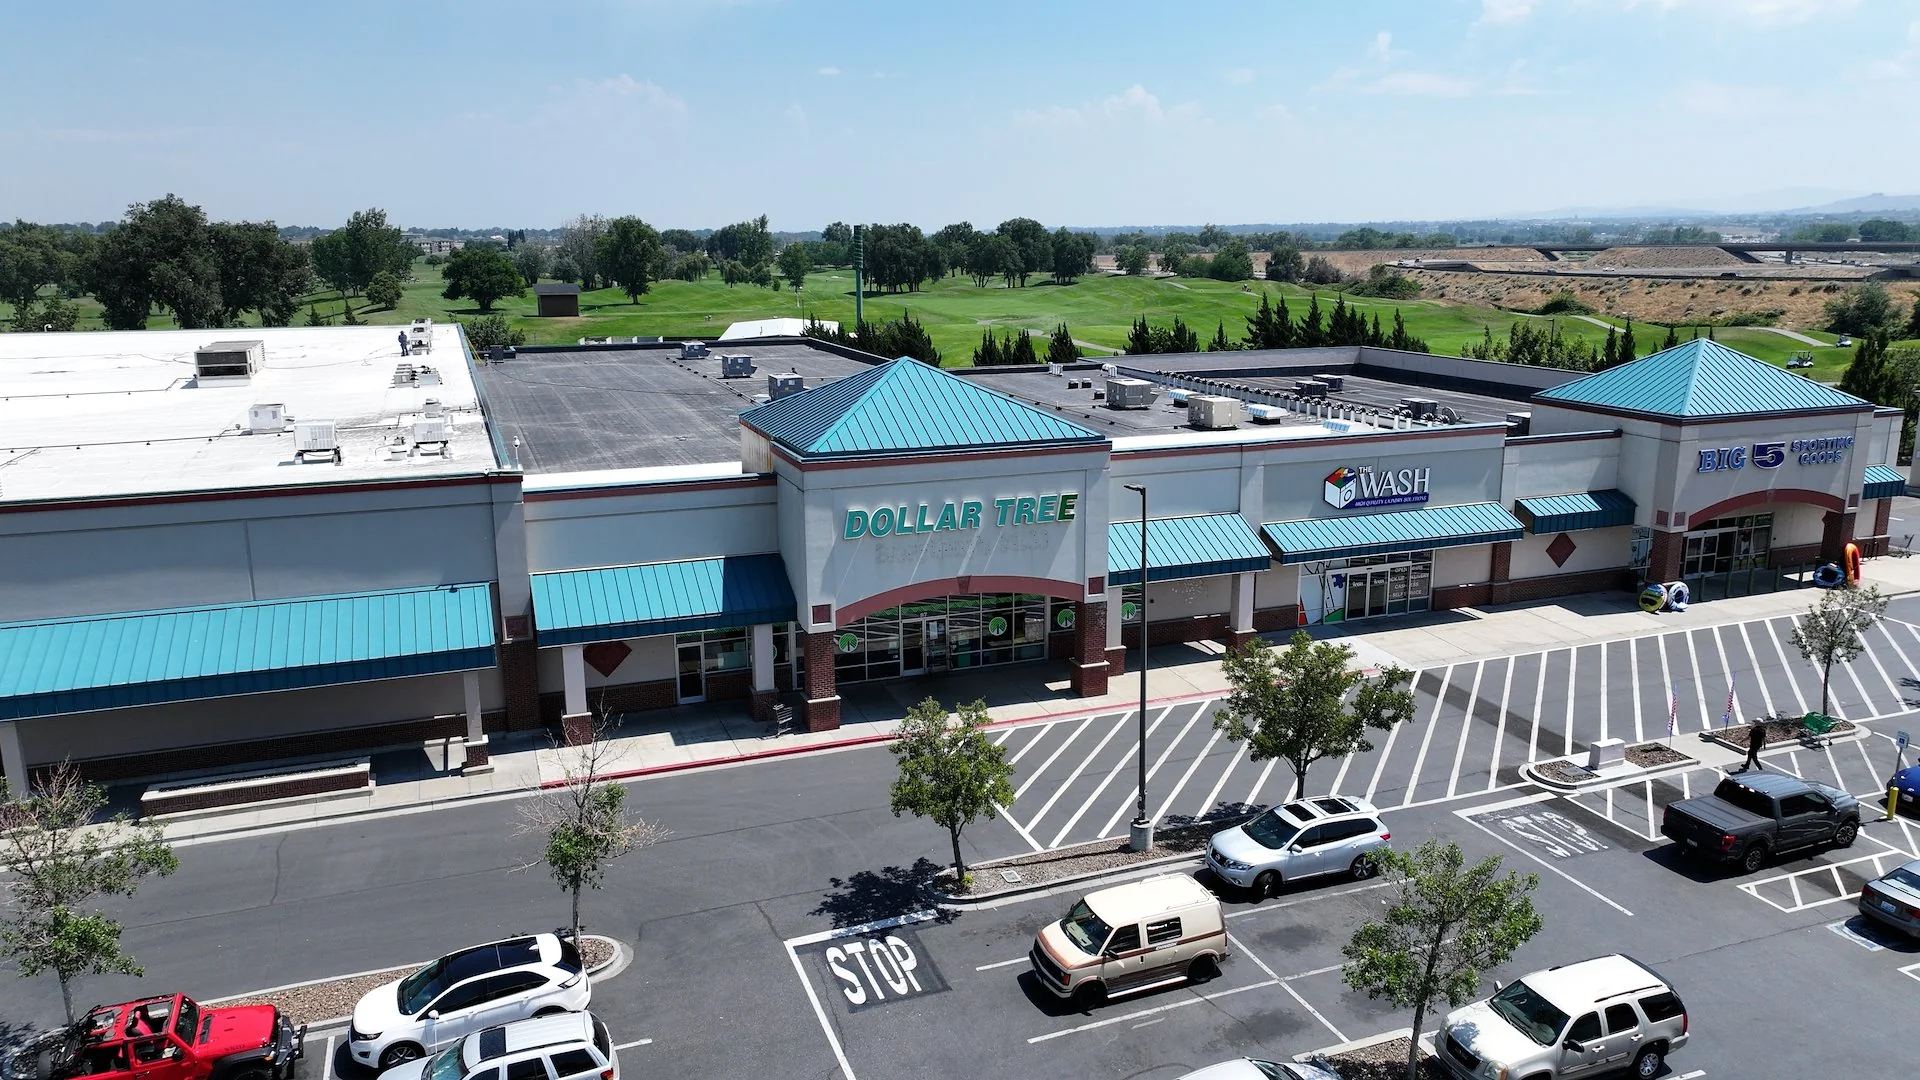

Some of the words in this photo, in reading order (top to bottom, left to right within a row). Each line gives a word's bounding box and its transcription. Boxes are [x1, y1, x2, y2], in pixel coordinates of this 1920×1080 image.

[1698, 446, 1747, 473] BIG
[1753, 442, 1786, 469] 5
[1791, 436, 1854, 452] SPORTING
[1800, 450, 1842, 465] GOODS
[1359, 468, 1430, 498] WASH
[844, 500, 983, 539] DOLLAR
[994, 493, 1079, 527] TREE
[825, 936, 922, 1004] STOP
